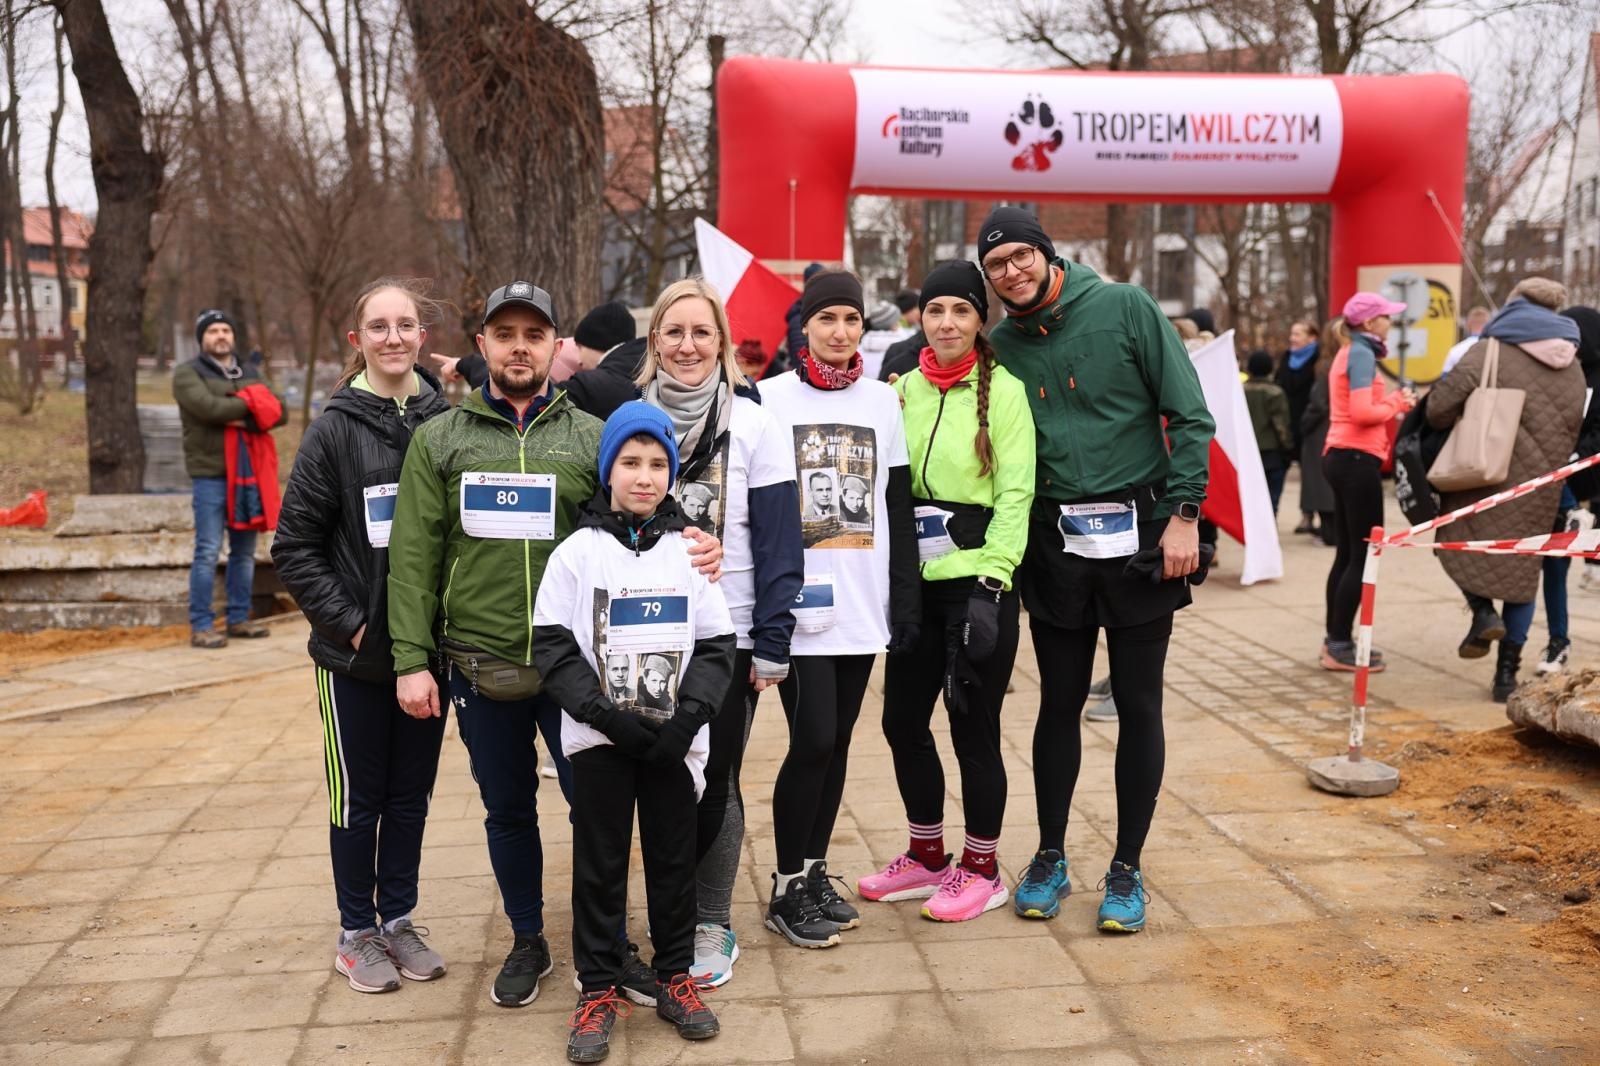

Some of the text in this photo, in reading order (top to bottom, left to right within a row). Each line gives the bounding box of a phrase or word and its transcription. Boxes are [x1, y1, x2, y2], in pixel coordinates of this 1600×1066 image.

[900, 141, 943, 158] Kultury
[827, 445, 873, 459] WICZYM
[496, 491, 519, 505] 80
[1087, 518, 1104, 530] 15
[641, 601, 662, 617] 79
